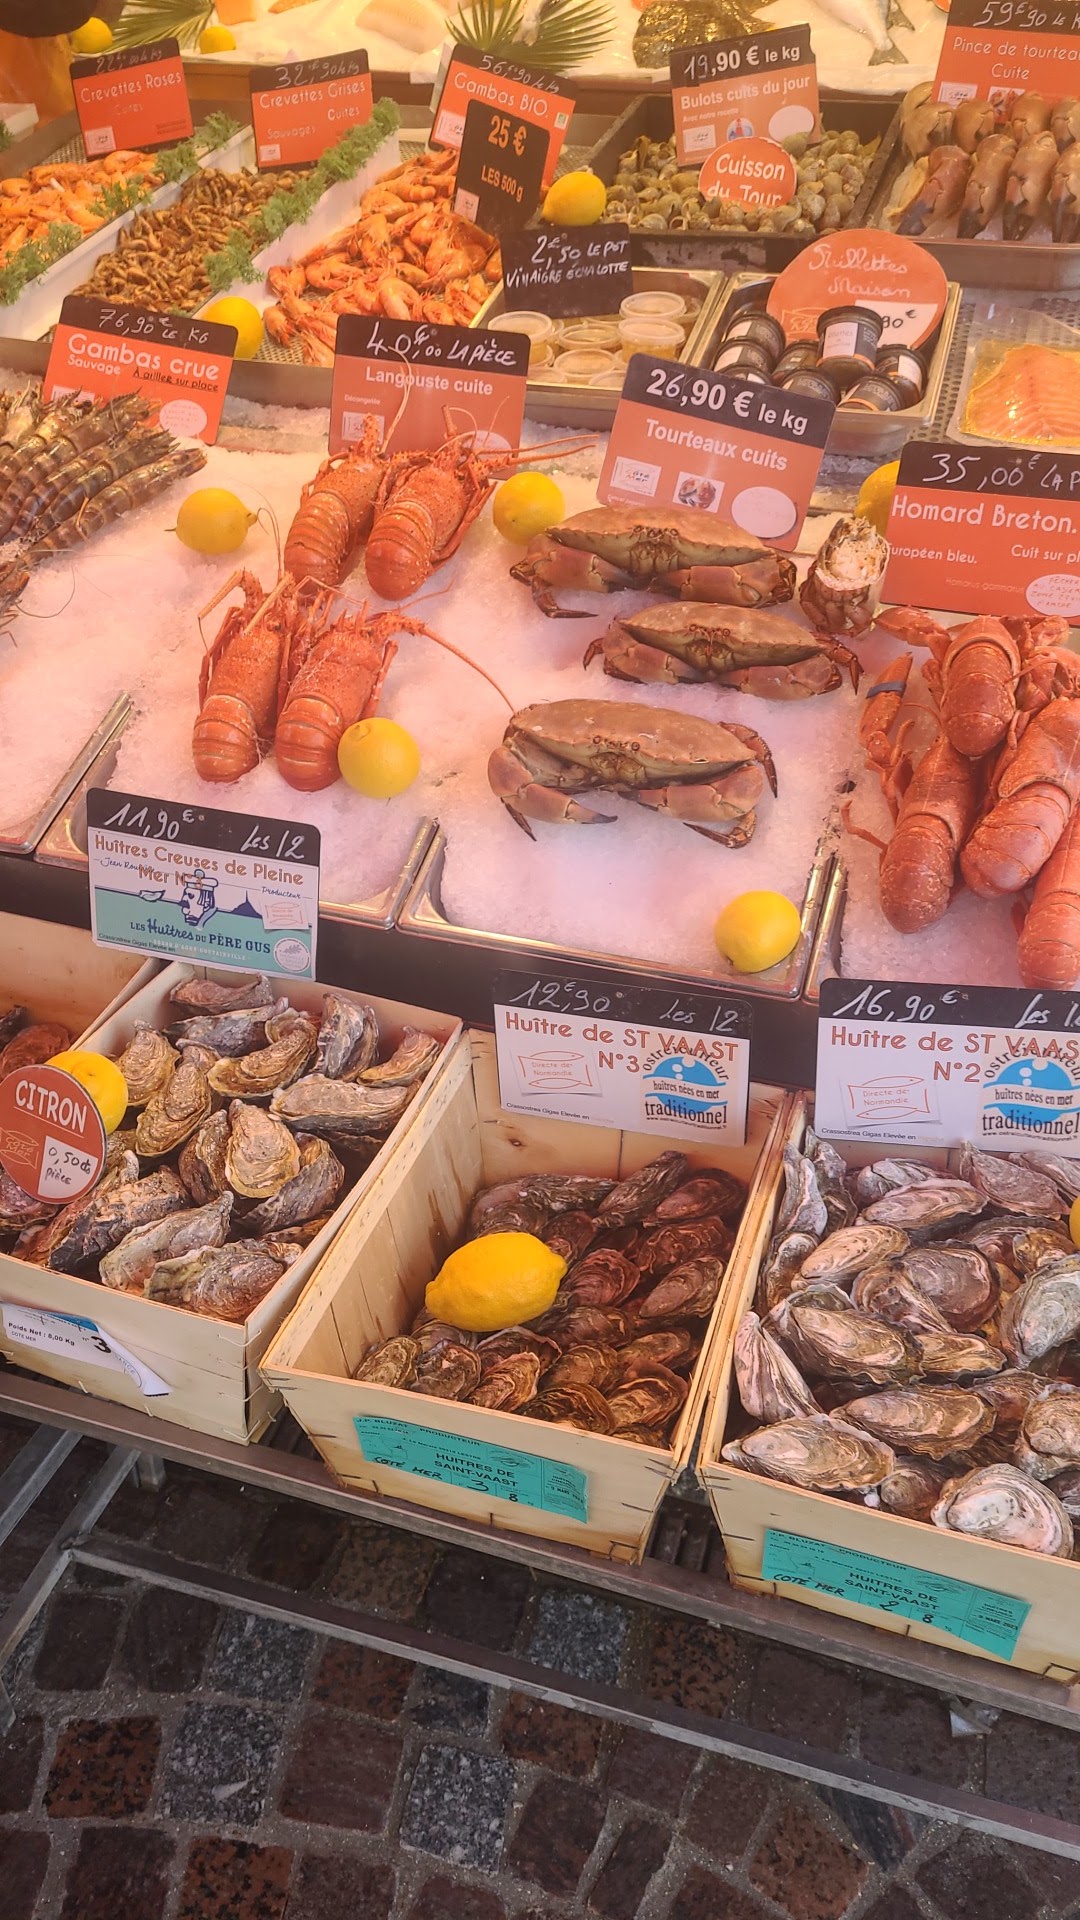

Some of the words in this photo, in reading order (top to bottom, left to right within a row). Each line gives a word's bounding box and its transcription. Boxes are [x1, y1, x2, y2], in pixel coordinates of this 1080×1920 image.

[953, 37, 992, 54] Pince
[997, 41, 1017, 56] de
[1023, 44, 1080, 60] tourtea
[684, 49, 741, 80] 19,90
[746, 45, 760, 66] €
[765, 49, 778, 63] le
[782, 46, 800, 61] kg
[991, 63, 1030, 80] Cuite
[81, 80, 142, 103] Crevettes
[145, 71, 181, 89] Roses
[260, 88, 323, 108] Crevettes
[328, 81, 365, 98] Grises
[454, 72, 515, 106] Gambas
[680, 91, 723, 110] Bulots
[727, 83, 759, 101] cuits
[763, 80, 780, 95] du
[782, 75, 811, 95] jour
[328, 106, 360, 121] Cuites
[488, 115, 511, 148] 25
[513, 125, 527, 156] €
[716, 153, 785, 181] Cuisson
[481, 165, 500, 187] LES
[501, 175, 517, 195] 500
[516, 184, 524, 203] g
[707, 180, 731, 199] du
[828, 276, 911, 299] Maison
[68, 333, 161, 369] Gambas
[170, 358, 220, 381] crue
[68, 354, 121, 375] Sauvage
[175, 378, 188, 387] sur
[191, 380, 219, 392] place
[366, 366, 449, 390] Langouste
[453, 378, 493, 396] cuite
[646, 368, 726, 411] 26,90
[733, 391, 754, 417] €
[758, 404, 777, 424] le
[781, 409, 808, 436] kg
[646, 418, 737, 458] Tourteaux
[742, 447, 788, 471] cuits
[891, 495, 984, 525] Homard
[992, 504, 1077, 534] Breton.
[1011, 545, 1039, 559] Cuit
[1043, 550, 1063, 561] sur
[95, 834, 149, 859] Huîtres
[154, 846, 219, 872] Creuses
[225, 860, 247, 876] de
[253, 863, 304, 886] Pleine
[139, 864, 169, 883] Mer
[130, 921, 146, 932] LES
[147, 918, 194, 941] Huîtres
[195, 934, 207, 943] DU
[209, 932, 242, 949] PÈRE
[245, 939, 271, 954] GUS
[709, 1005, 739, 1032] 12
[506, 1012, 572, 1037] Huître
[582, 1024, 614, 1044] de
[623, 1029, 650, 1049] ST
[658, 1033, 738, 1062] VAAST
[831, 1026, 906, 1048] Huître
[918, 1032, 953, 1050] de
[964, 1034, 996, 1054] ST
[1005, 1035, 1080, 1060] VAAS
[599, 1050, 640, 1073] N°3
[933, 1061, 981, 1083] N°2
[15, 1079, 87, 1133] CITRON
[696, 1089, 704, 1098] en
[706, 1090, 719, 1098] mer
[863, 1097, 909, 1106] Normandie
[1045, 1094, 1055, 1105] en
[1057, 1095, 1073, 1105] mer
[645, 1097, 727, 1124] traditionnel
[982, 1109, 1080, 1135] traditionnel
[8, 1322, 28, 1333] Poids
[29, 1327, 42, 1337] Net
[90, 1335, 112, 1354] 3
[420, 1428, 480, 1446] PRODUCTEUR
[412, 1466, 442, 1479] MER
[434, 1460, 518, 1488] SAINT-VAAST
[436, 1453, 493, 1472] HUITRES
[497, 1468, 515, 1479] DE
[467, 1479, 489, 1491] 3
[509, 1493, 518, 1502] 8
[839, 1548, 907, 1570] PRODUCTEUR
[815, 1582, 846, 1596] MER
[845, 1579, 939, 1610] SAINT-VAAST
[849, 1573, 913, 1595] HUITRES
[918, 1592, 938, 1602] DE
[880, 1601, 900, 1611] 2
[922, 1613, 934, 1623] 8
